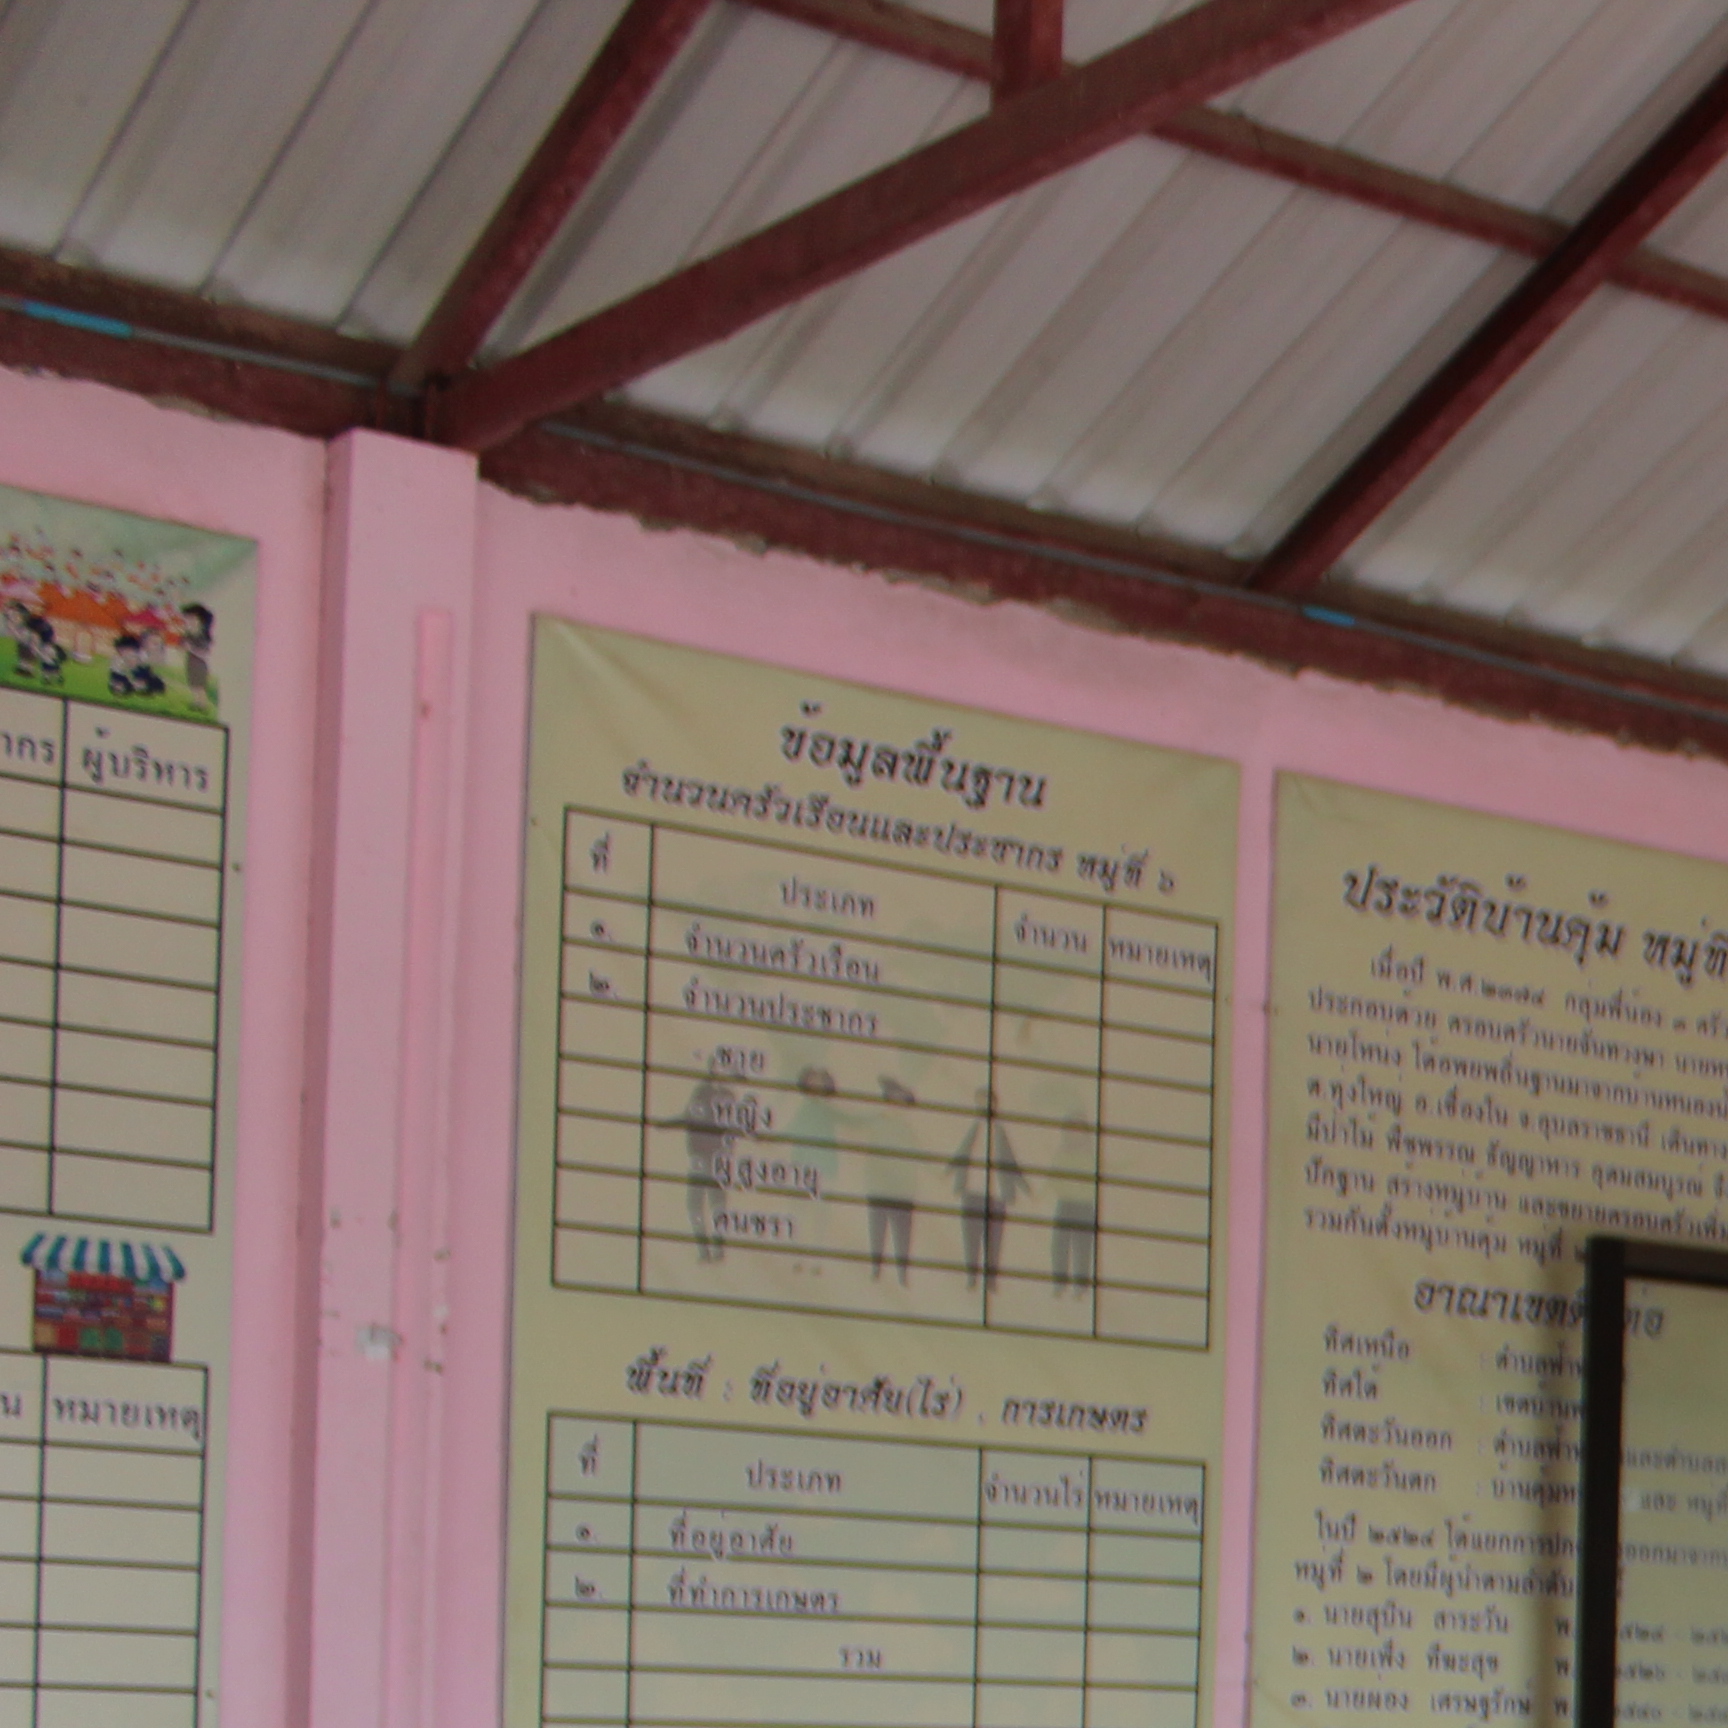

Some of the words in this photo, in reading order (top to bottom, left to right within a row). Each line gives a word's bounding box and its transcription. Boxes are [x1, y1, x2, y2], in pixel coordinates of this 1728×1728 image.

[81, 725, 210, 795] ผู้บริหาร
[780, 701, 1047, 810] ข้อมูลพื้นฐาน
[621, 759, 1063, 872] จำนวนครัวเรือนและประชากร
[1076, 845, 1151, 894] หมู่ที่
[589, 831, 611, 873] ที่
[779, 876, 876, 919] ประเภท
[1342, 865, 1625, 967] ประวัติบ้านคุ้ม
[685, 922, 880, 984] จำนวนครัวเรือน
[1013, 913, 1089, 954] จำนวน
[1107, 938, 1212, 983] หมายเหตุ
[1369, 944, 1426, 984] เมื่อปี
[682, 975, 879, 1037] จำนวนประชากร
[1322, 1322, 1410, 1361] ทิศเหนือ
[625, 1346, 715, 1400] พื้นที่
[1001, 1397, 1149, 1434] การเกษตร
[1321, 1362, 1379, 1401] ทิศใต้
[52, 1398, 201, 1442] หมายเหตุ
[1319, 1410, 1453, 1452] ทิศตะวันออก
[578, 1433, 599, 1476] ที่
[1318, 1455, 1437, 1494] ทิศตะวันตก
[745, 1459, 842, 1494] ประเภท
[985, 1469, 1084, 1509] จำนวนไร่
[1095, 1488, 1199, 1527] หมายเหตุ
[668, 1509, 794, 1560] ที่อยู่อาศัย
[667, 1566, 840, 1614] ที่ทำการเกษตร
[838, 1645, 881, 1670] รวม
